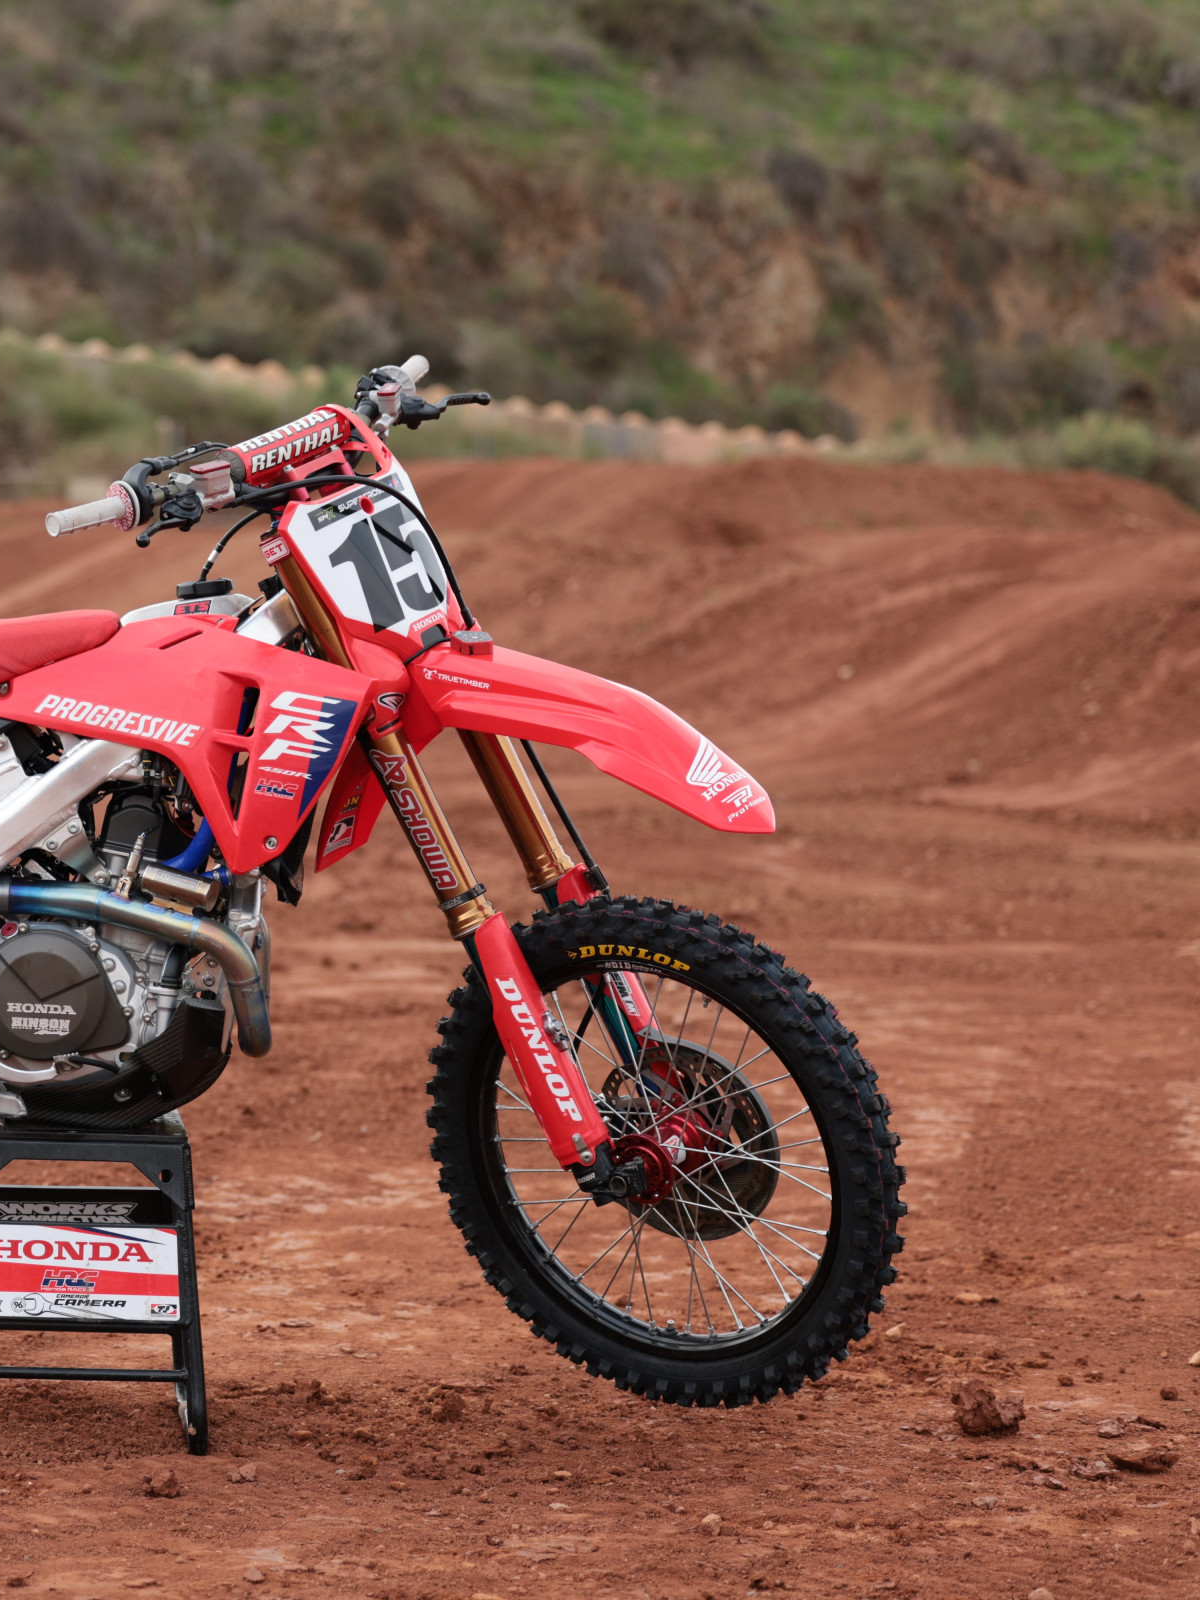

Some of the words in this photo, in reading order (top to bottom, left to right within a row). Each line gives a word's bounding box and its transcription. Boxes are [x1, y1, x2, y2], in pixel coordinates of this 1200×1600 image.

[239, 410, 337, 453] RENTHAL
[251, 423, 343, 474] RENTHAL
[328, 503, 445, 634] 15
[175, 600, 210, 615] ETS
[412, 612, 444, 631] HONDA
[437, 673, 490, 690] TRUETIMBER
[34, 694, 201, 747] PROGRESSIVE
[258, 690, 342, 760] CRF
[257, 766, 313, 781] 450R
[255, 778, 299, 798] HRC
[701, 771, 747, 802] HONDA
[727, 807, 746, 823] Pro
[745, 795, 767, 811] Honda
[390, 787, 459, 890] SHOWA
[578, 944, 691, 971] DUNLOP
[6, 1002, 77, 1016] HONDA
[11, 1016, 71, 1031] HINSON
[495, 977, 583, 1122] DUNLOP
[41, 1269, 100, 1288] HRC
[13, 1301, 23, 1309] 96
[54, 1298, 127, 1308] CAMERA
